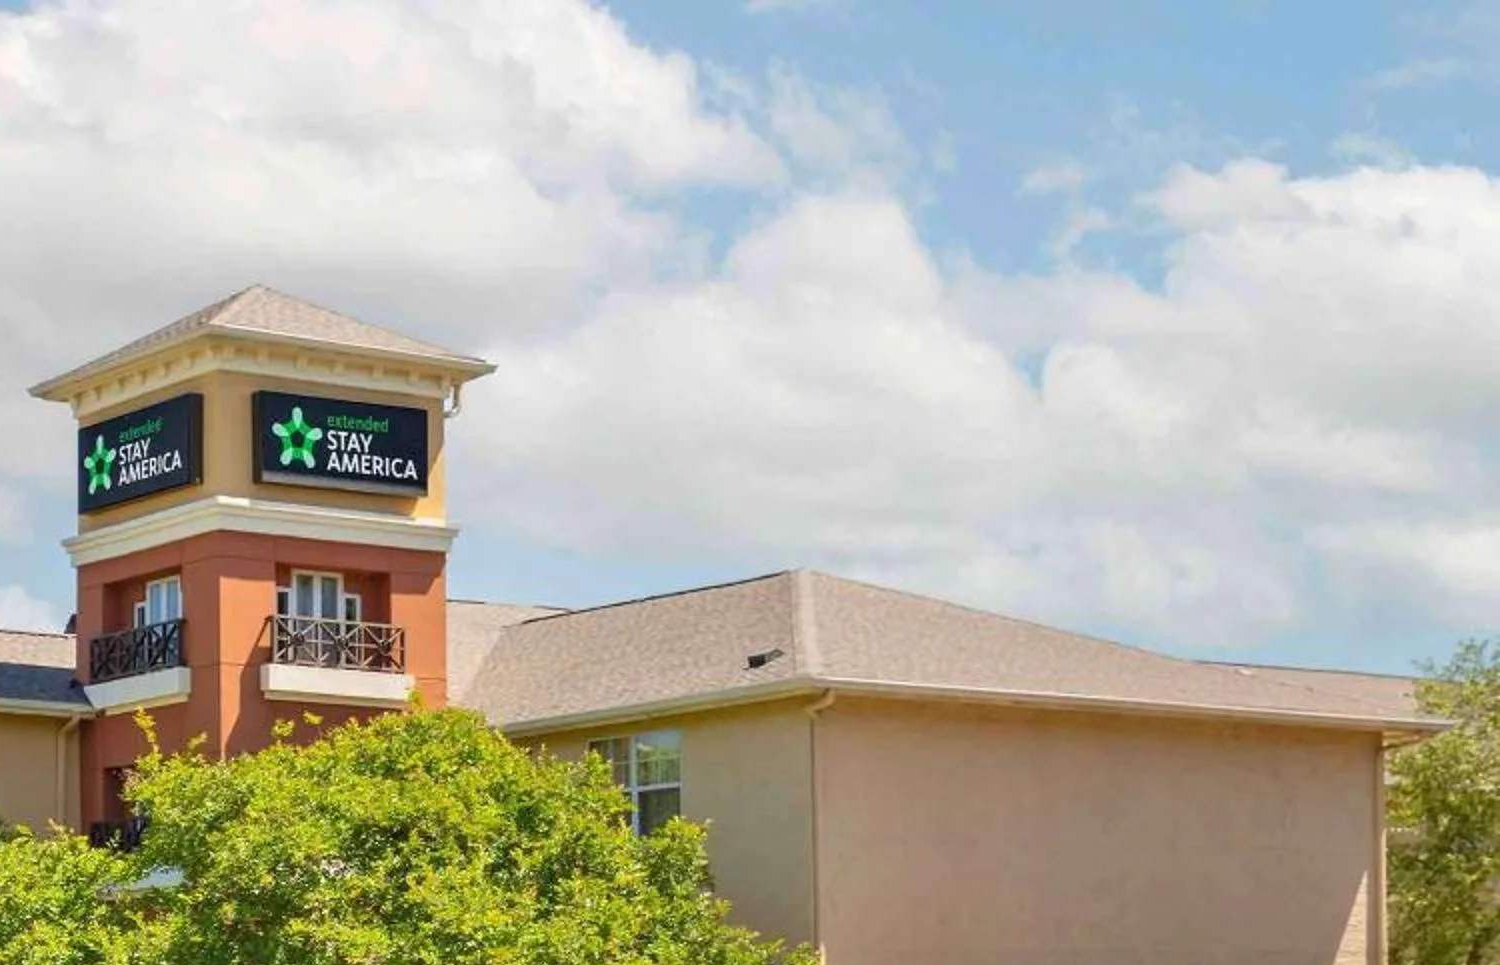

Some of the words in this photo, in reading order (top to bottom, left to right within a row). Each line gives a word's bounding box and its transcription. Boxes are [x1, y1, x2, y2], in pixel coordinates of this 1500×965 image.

[119, 418, 163, 443] extended
[327, 415, 388, 433] extended
[119, 437, 151, 465] STAY
[327, 430, 373, 453] STAY
[118, 449, 182, 487] AMERICA
[327, 452, 418, 480] AMERICA
